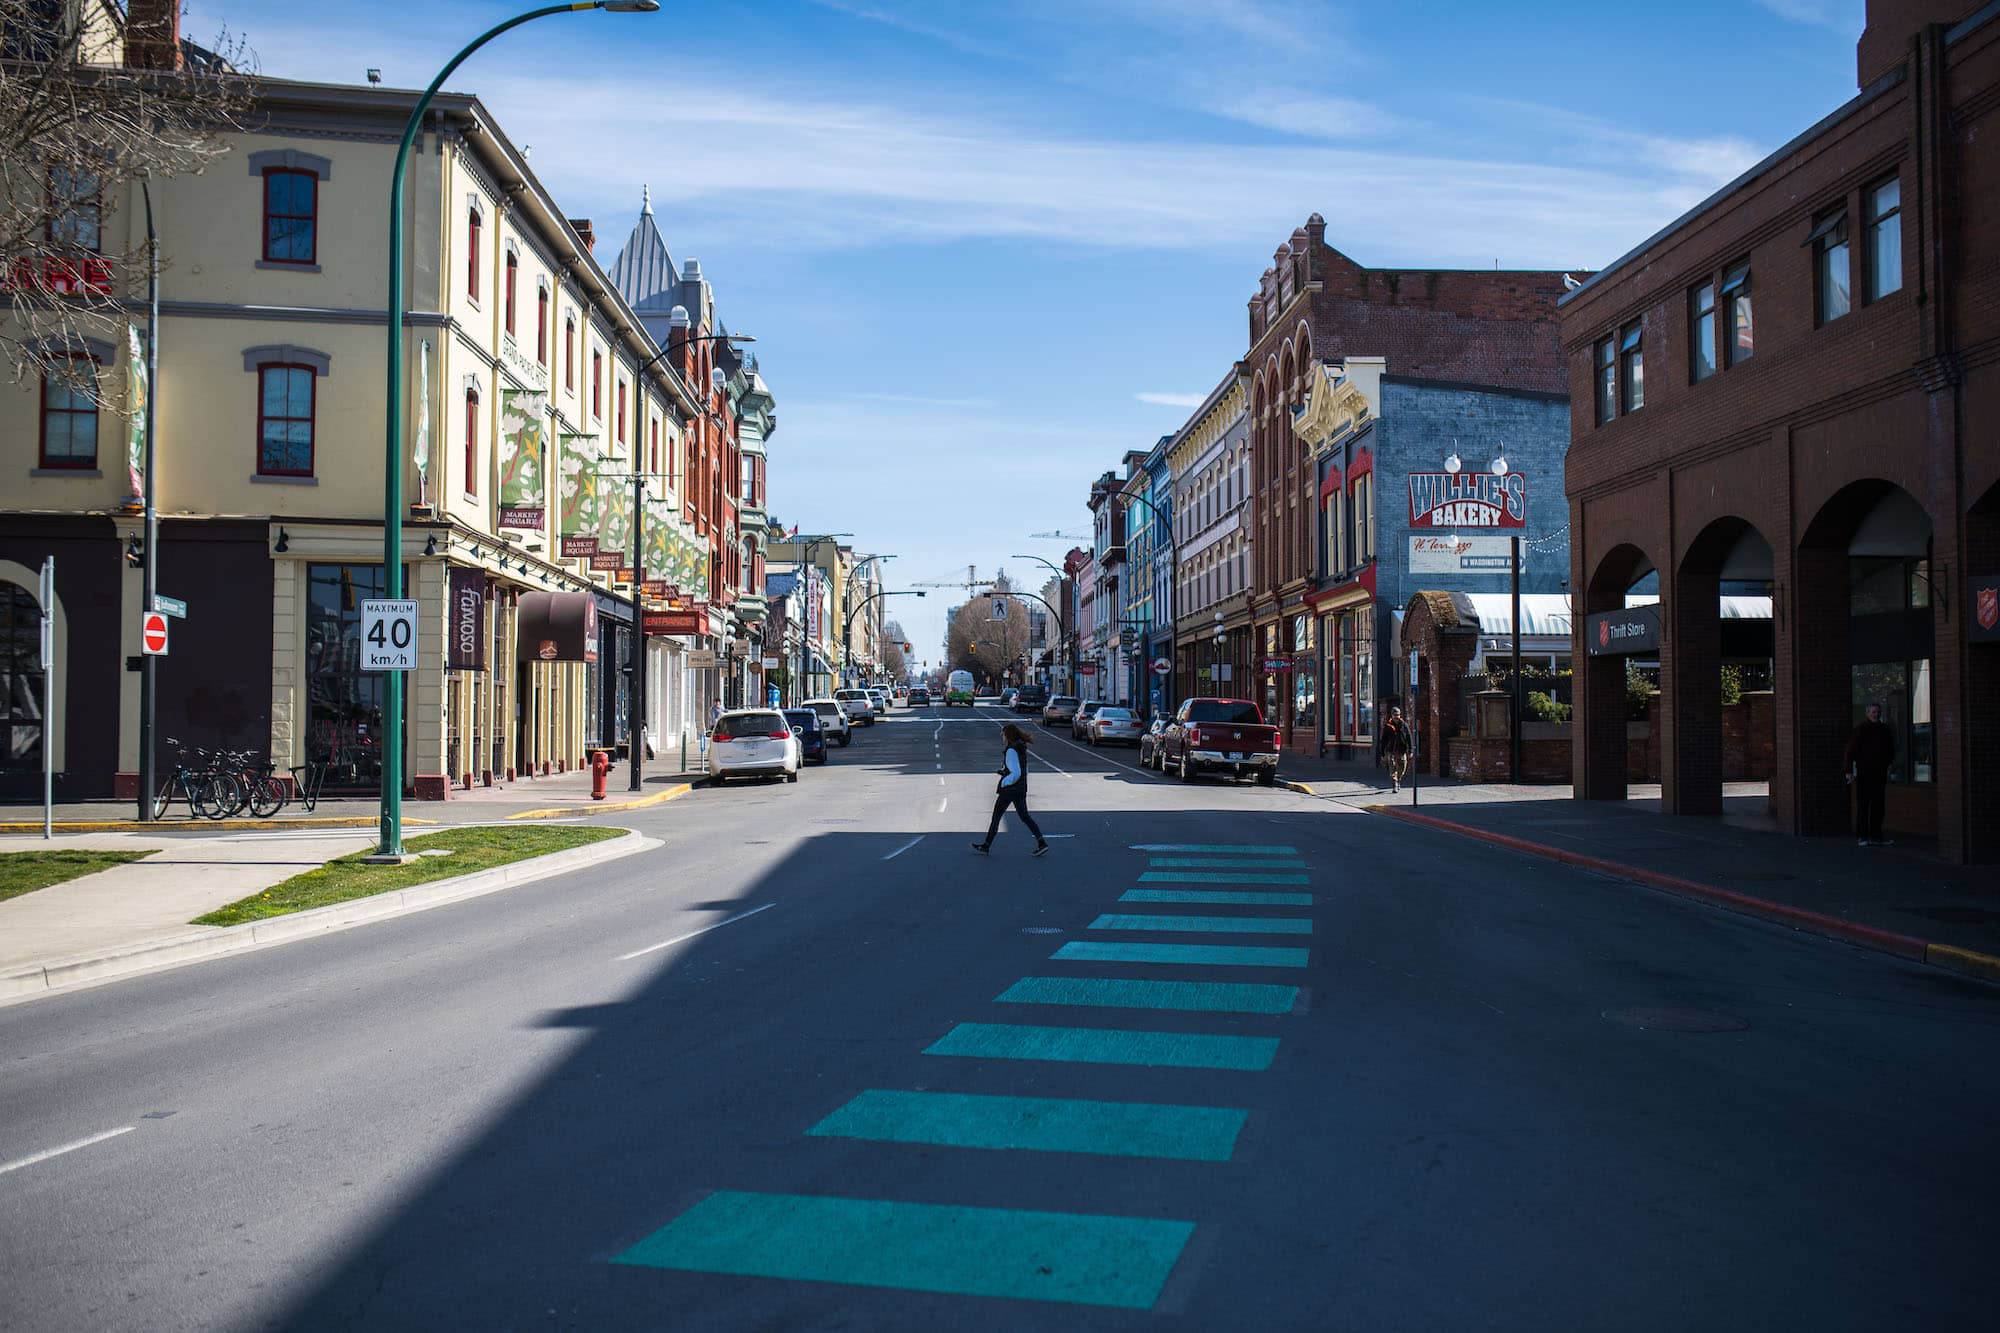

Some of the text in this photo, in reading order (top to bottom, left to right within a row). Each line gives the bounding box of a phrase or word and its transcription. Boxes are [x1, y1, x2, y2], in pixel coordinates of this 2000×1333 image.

[1409, 473, 1524, 521] WILLIE'S
[505, 511, 538, 520] MARKET
[1432, 502, 1502, 526] BAKERY
[504, 517, 539, 526] SQUARE
[566, 547, 594, 555] SQUARE
[367, 605, 413, 613] MAXIMUM
[645, 617, 691, 626] ENTRANCE
[367, 618, 411, 649] 40
[1610, 622, 1646, 639] Thrift Store
[371, 653, 407, 665] km/h
